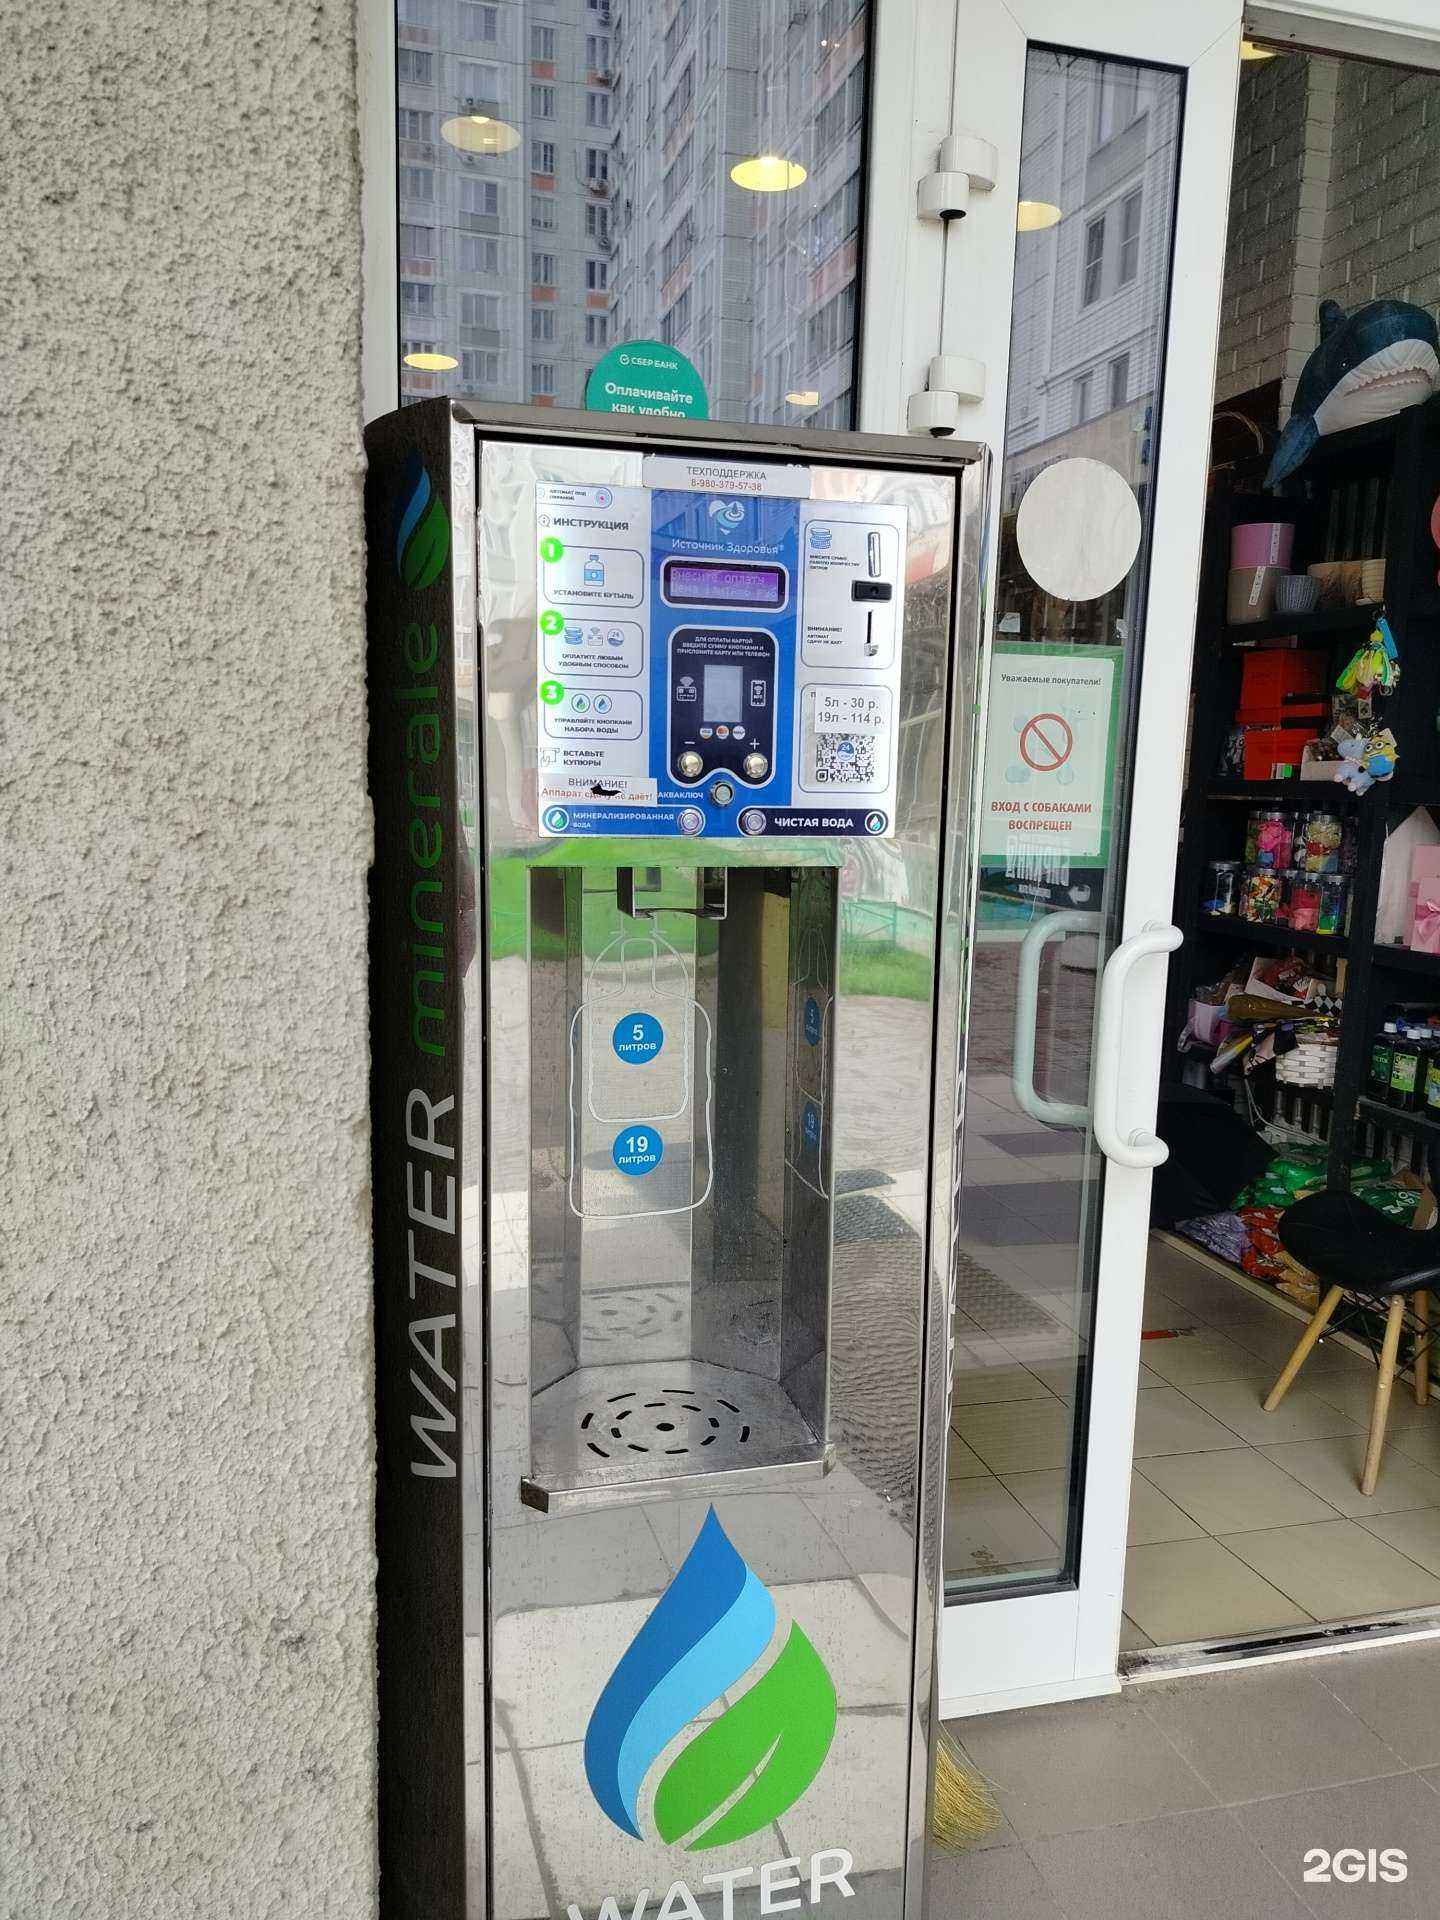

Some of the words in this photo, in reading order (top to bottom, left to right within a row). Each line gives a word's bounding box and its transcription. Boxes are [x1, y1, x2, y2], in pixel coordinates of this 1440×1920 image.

[605, 382, 693, 404] Оплачивайте
[611, 403, 635, 414] как
[686, 465, 767, 480] ТЕХПОДДЕРЖКА
[691, 478, 762, 491] 8-980-379-57-38
[553, 518, 629, 531] ИНСТРУКЦИЯ
[672, 538, 725, 551] Источник
[553, 589, 602, 598] УСТАНОВИТЕ
[603, 592, 634, 600] БУТЫЛЬ
[547, 617, 557, 629] 2
[1001, 673, 1050, 684] Уважаемые
[1052, 676, 1101, 686] покупатели!
[547, 685, 557, 699] 3
[825, 696, 839, 707] 5л
[851, 697, 864, 708] 30
[868, 700, 879, 711] р.
[818, 712, 839, 723] 19л
[852, 713, 870, 724] 114
[563, 750, 605, 758] ВСТАВЬТЕ
[563, 759, 602, 767] КУПЮРЫ
[568, 777, 628, 789] ВНИМАНИЕ!
[542, 787, 582, 799] Аппарат
[657, 791, 704, 800] АКВАКЛЮЧ
[991, 801, 1021, 814] ВХОД
[1023, 802, 1030, 813] С
[1032, 802, 1092, 814] СОБАКАМИ
[573, 812, 675, 821] МИНЕРАЛИЗИРОВАННАЯ
[774, 818, 819, 827] ЧИСТАЯ
[822, 819, 854, 828] ВОДА
[1008, 819, 1072, 832] ВОСПРЕЩЕН
[393, 623, 446, 1056] minerale
[631, 1024, 644, 1041] 5
[618, 1041, 657, 1054] литров
[625, 1136, 649, 1154] 19
[618, 1154, 656, 1165] литров
[405, 1089, 456, 1478] WATER
